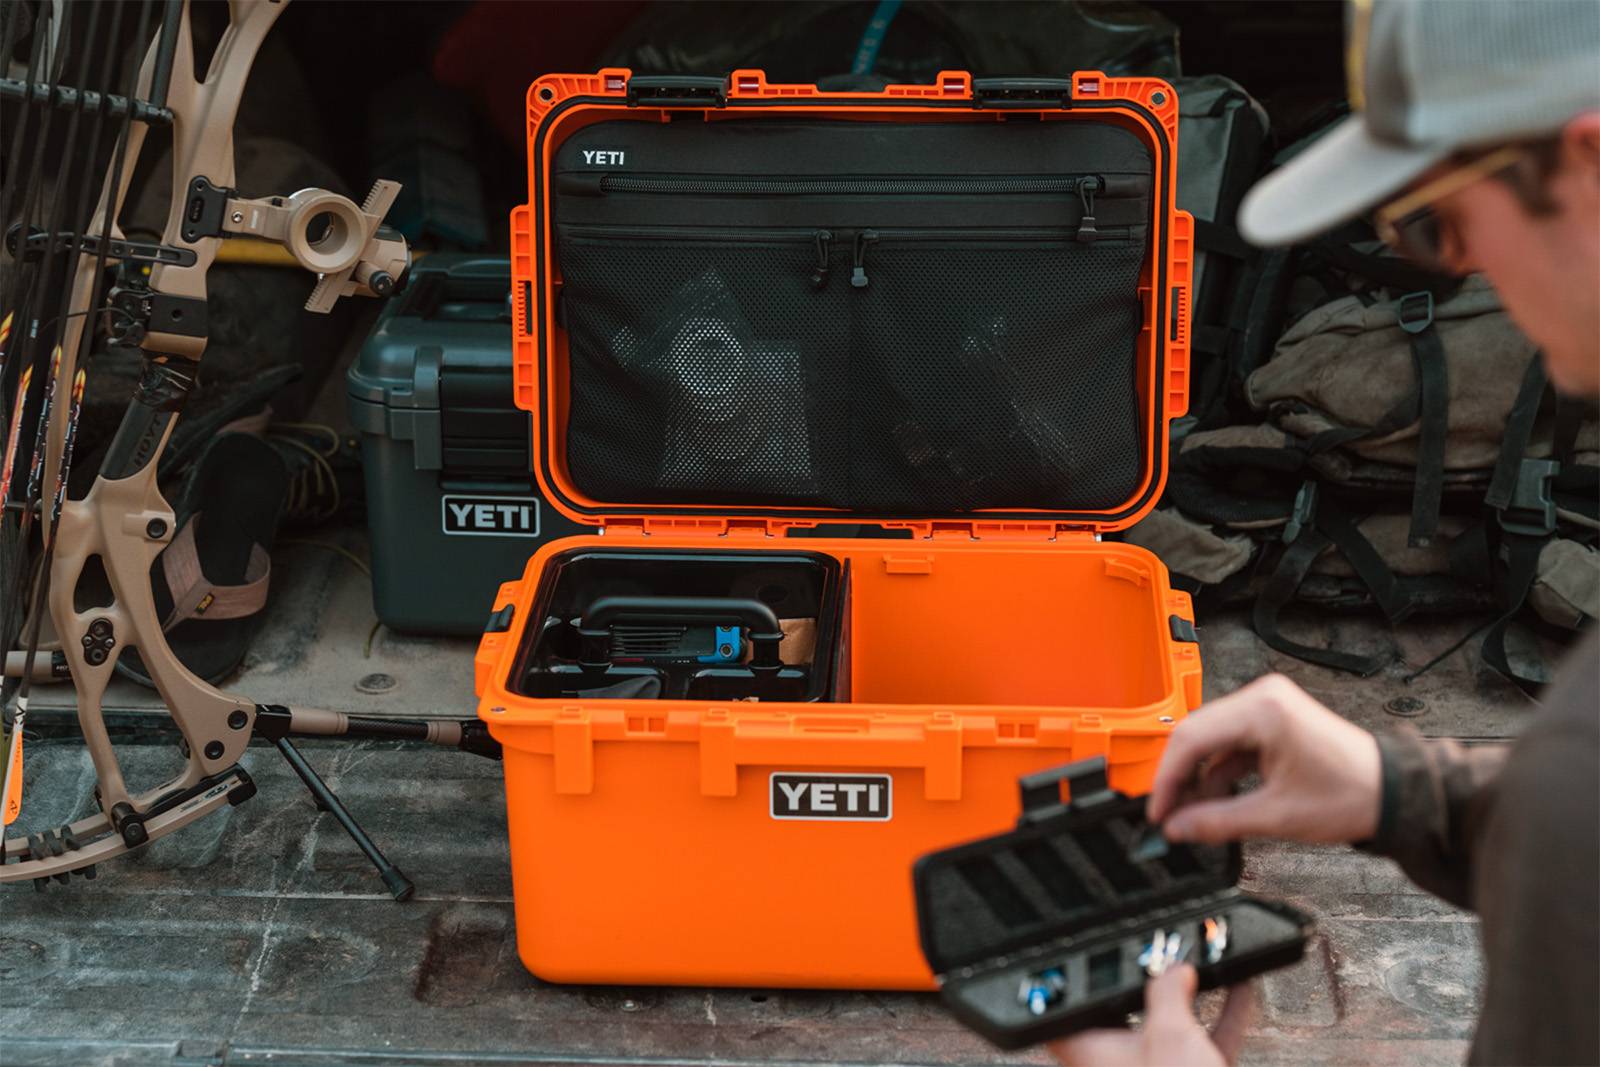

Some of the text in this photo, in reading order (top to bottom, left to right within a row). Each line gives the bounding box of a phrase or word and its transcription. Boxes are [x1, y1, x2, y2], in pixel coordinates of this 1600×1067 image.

[582, 150, 625, 165] YETI
[448, 503, 530, 529] YETI
[777, 782, 880, 812] YETI
